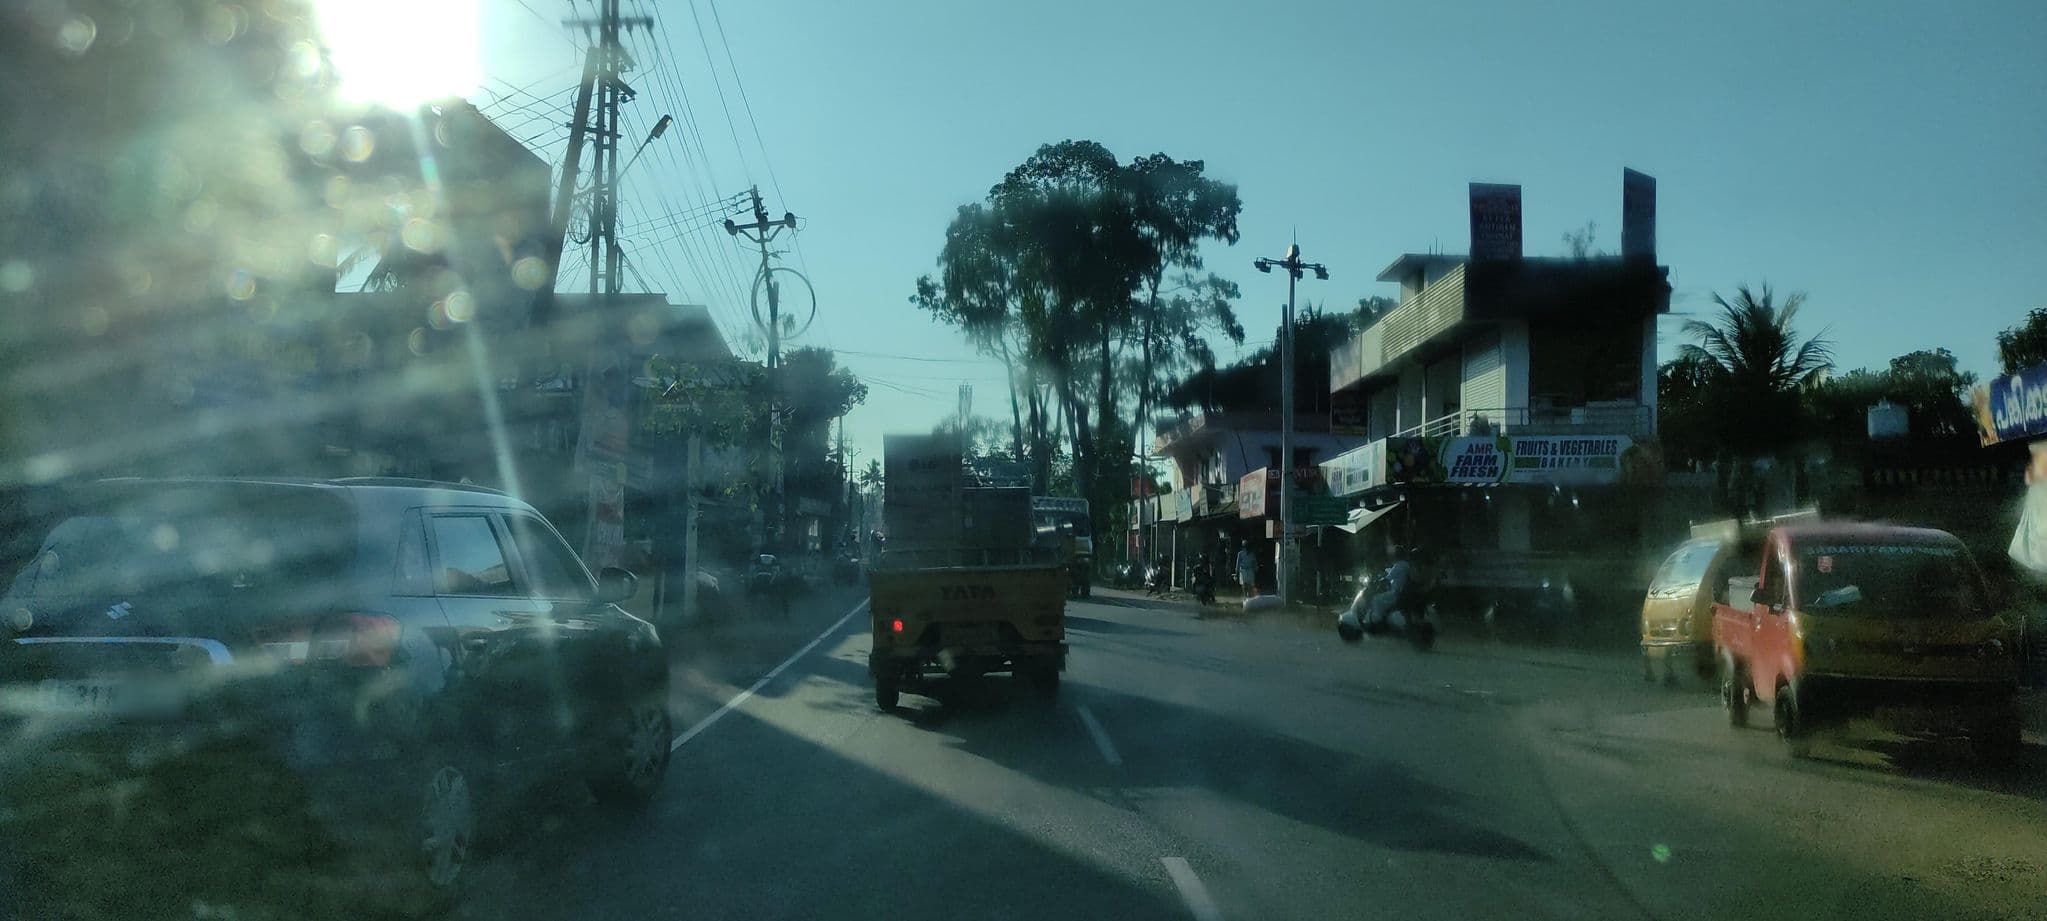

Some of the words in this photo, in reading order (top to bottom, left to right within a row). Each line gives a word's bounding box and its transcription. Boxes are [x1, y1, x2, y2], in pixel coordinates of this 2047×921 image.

[1467, 443, 1493, 454] AMR
[1516, 440, 1549, 456] FRUITS
[1551, 442, 1557, 456] &
[1559, 439, 1618, 456] VEGETABLES
[1455, 454, 1498, 466] FARM
[1451, 467, 1498, 477] FRESH
[940, 585, 994, 599] TATA
